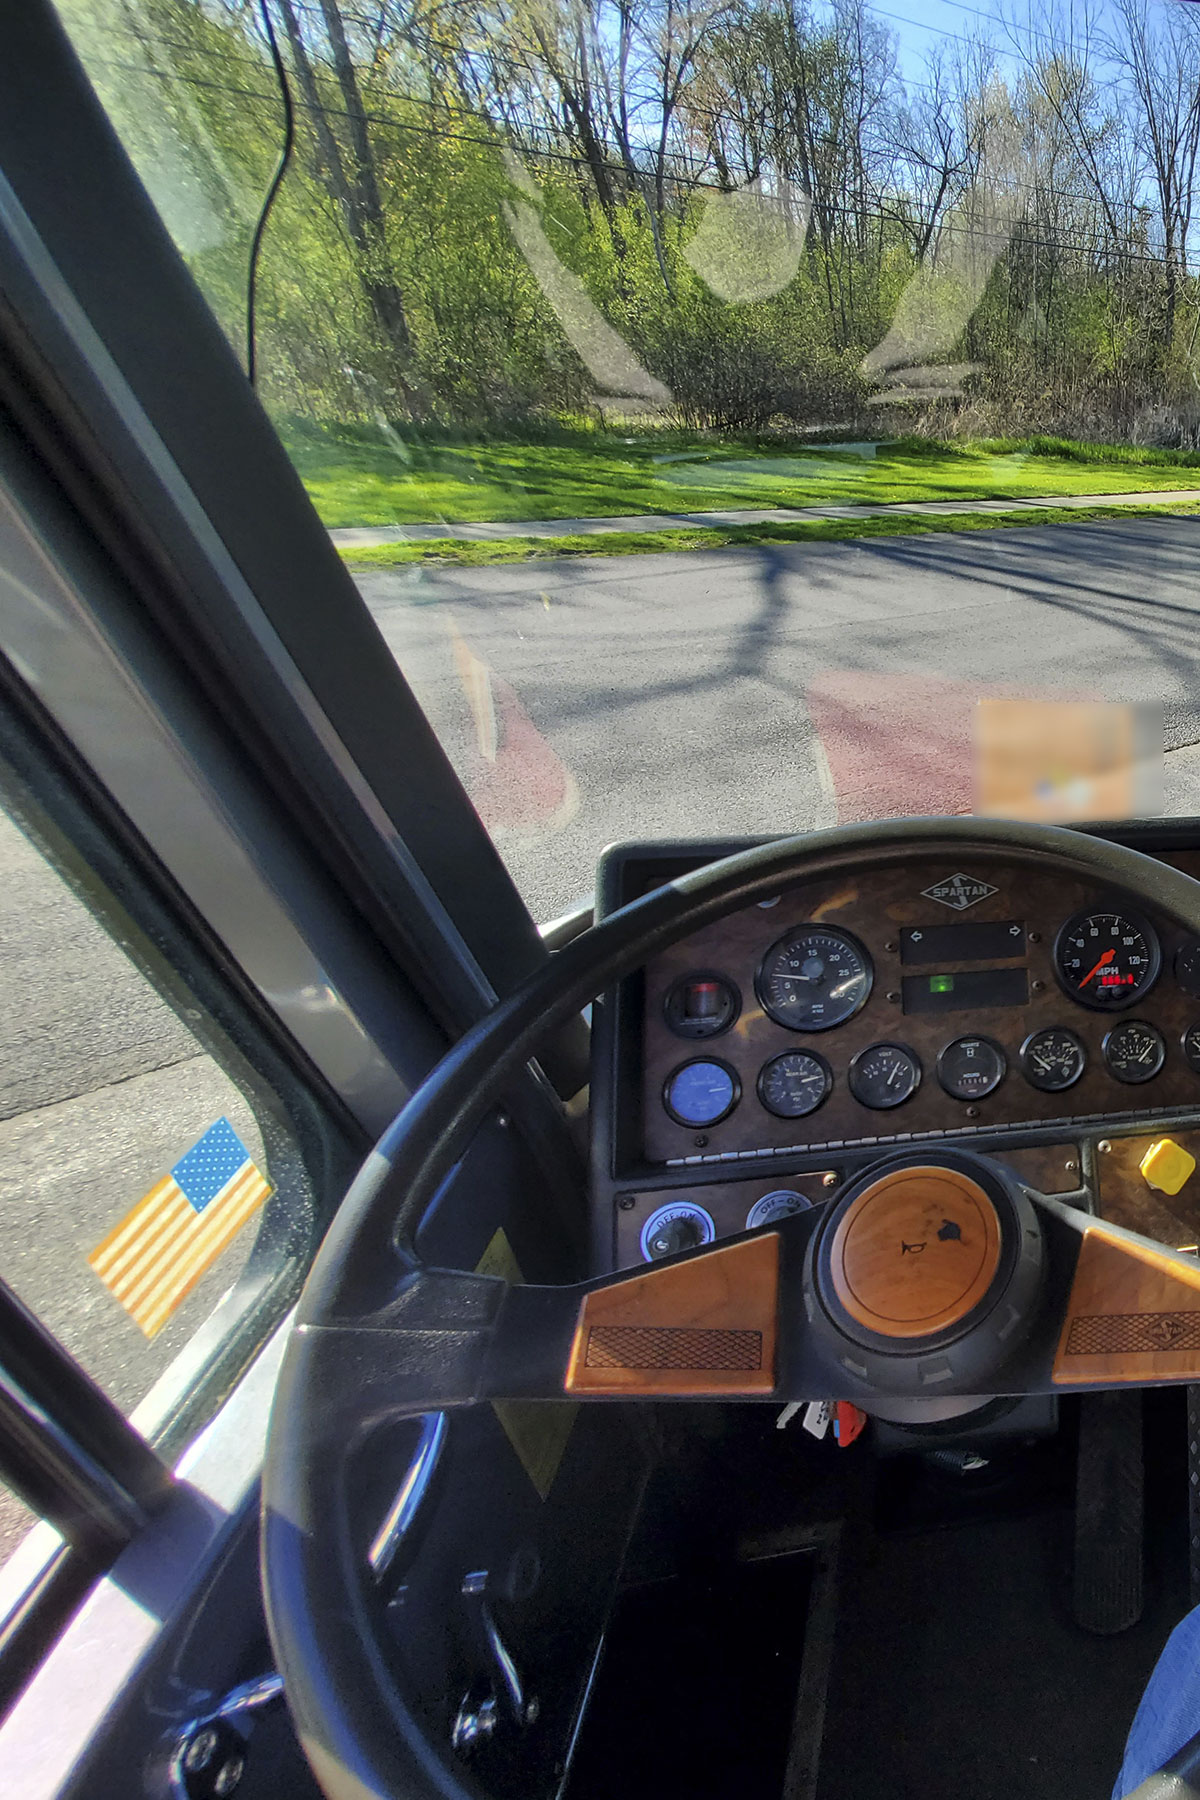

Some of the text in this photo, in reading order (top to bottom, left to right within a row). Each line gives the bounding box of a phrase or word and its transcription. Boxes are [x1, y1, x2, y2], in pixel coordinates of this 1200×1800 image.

[933, 885, 988, 897] SPARTAN
[1090, 927, 1099, 936] 60
[1075, 938, 1085, 948] 40
[1122, 936, 1134, 945] 100
[829, 954, 840, 962] 20
[1128, 955, 1140, 965] 120
[1071, 958, 1080, 968] 20
[838, 968, 850, 976] 25
[1096, 966, 1119, 975] MPH
[759, 1197, 801, 1215] OFF ON
